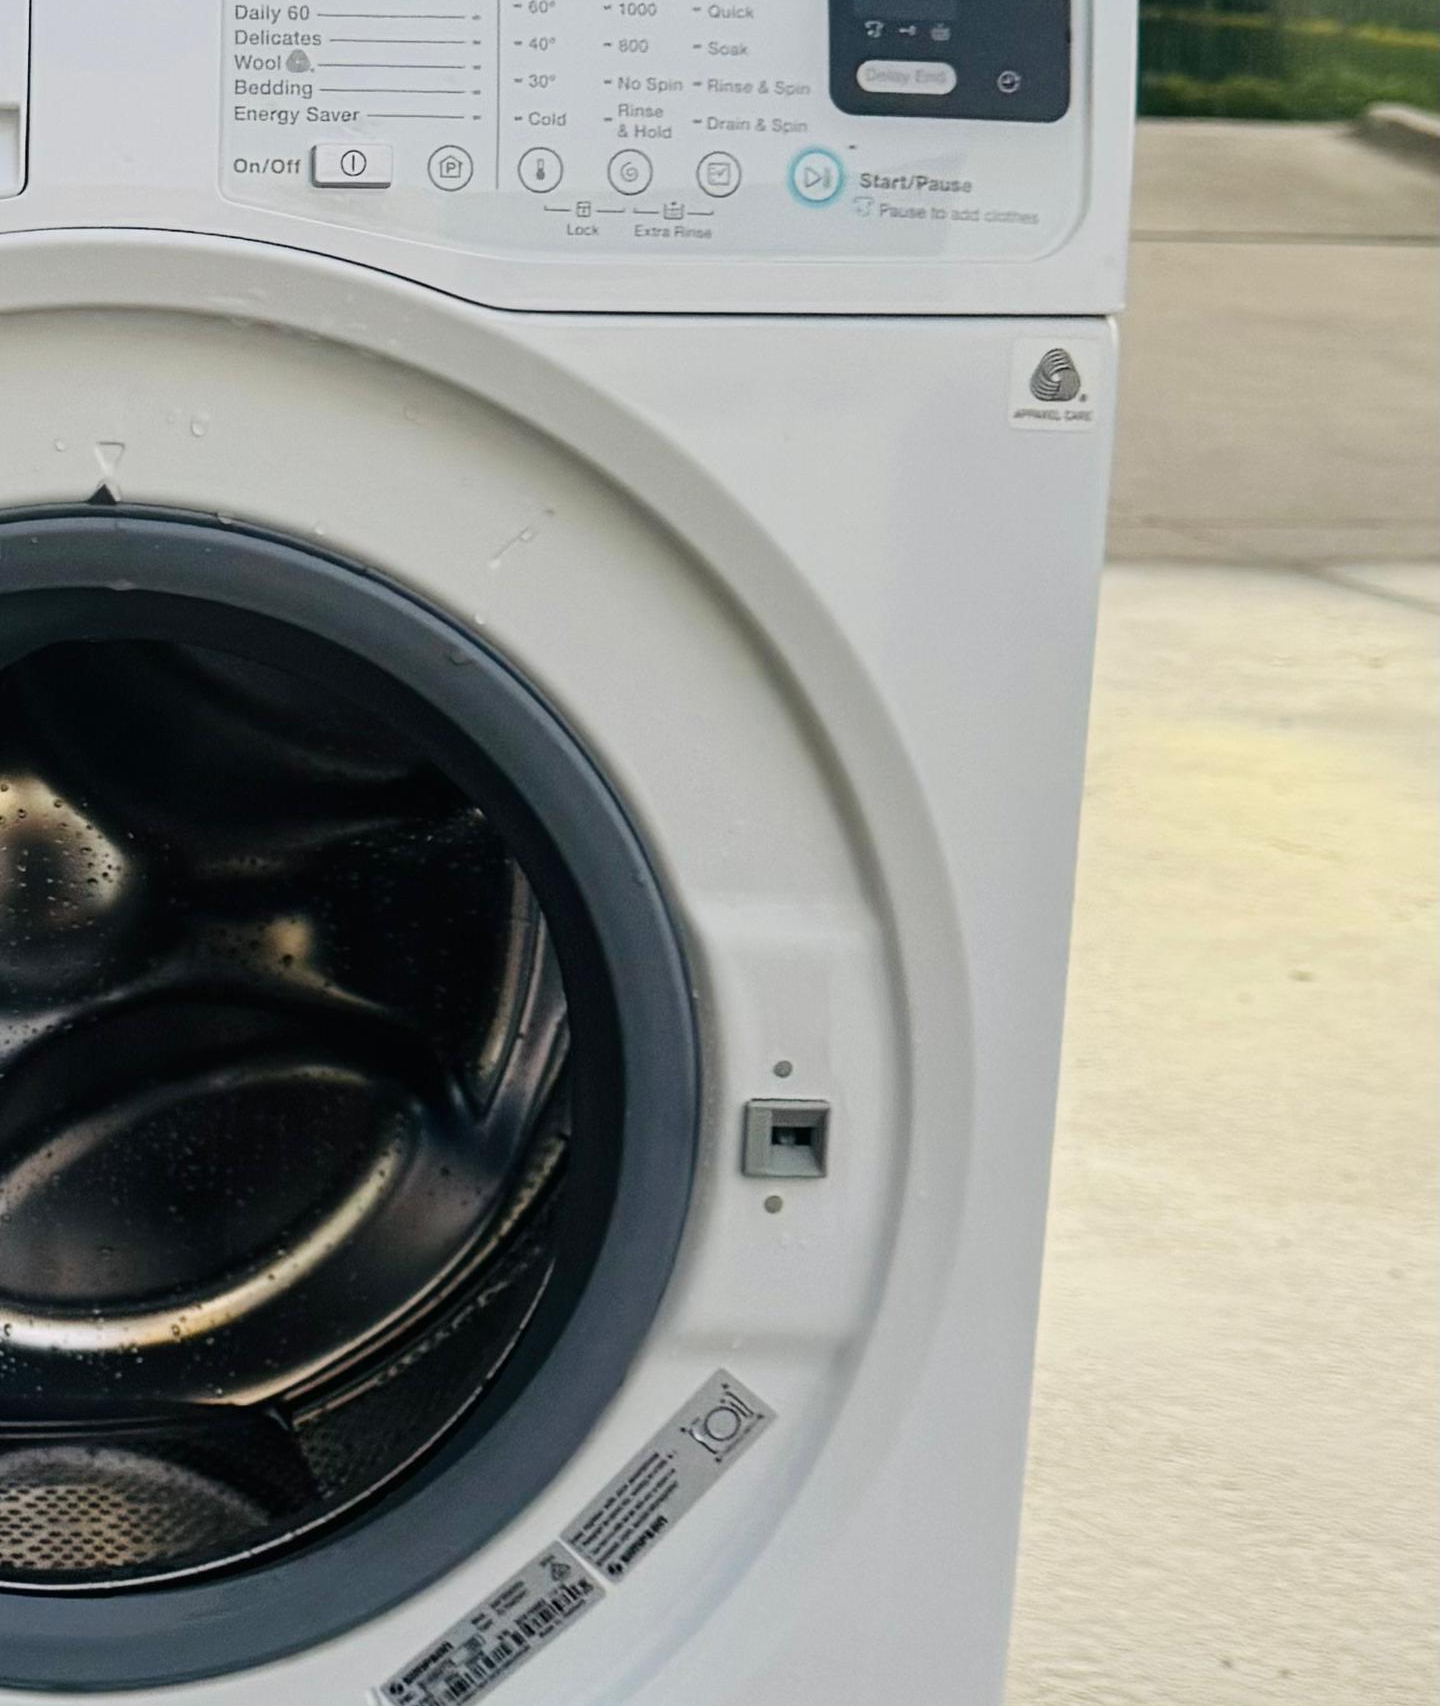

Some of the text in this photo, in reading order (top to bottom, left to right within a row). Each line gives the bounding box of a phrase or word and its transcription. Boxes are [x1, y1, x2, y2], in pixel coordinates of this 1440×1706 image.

[234, 5, 310, 23] Daily 60
[619, 2, 658, 16] 1000
[707, 5, 754, 20] Quick
[234, 30, 322, 46] Delicates
[618, 40, 649, 53] 800
[707, 42, 749, 56] Soak
[234, 55, 282, 71] Wool
[234, 80, 313, 99] Bedding
[618, 77, 683, 94] No Spin
[707, 79, 811, 97] Rinse & Spin
[234, 106, 360, 125] Energy Saver
[618, 104, 664, 118] Rinse
[528, 112, 567, 127] Cold
[707, 117, 808, 135] Drain & Spin
[617, 124, 672, 140] & Hold
[233, 157, 302, 175] On/Off
[860, 173, 972, 193] Start/Pause
[566, 223, 600, 237] Lock
[634, 224, 671, 238] Extra
